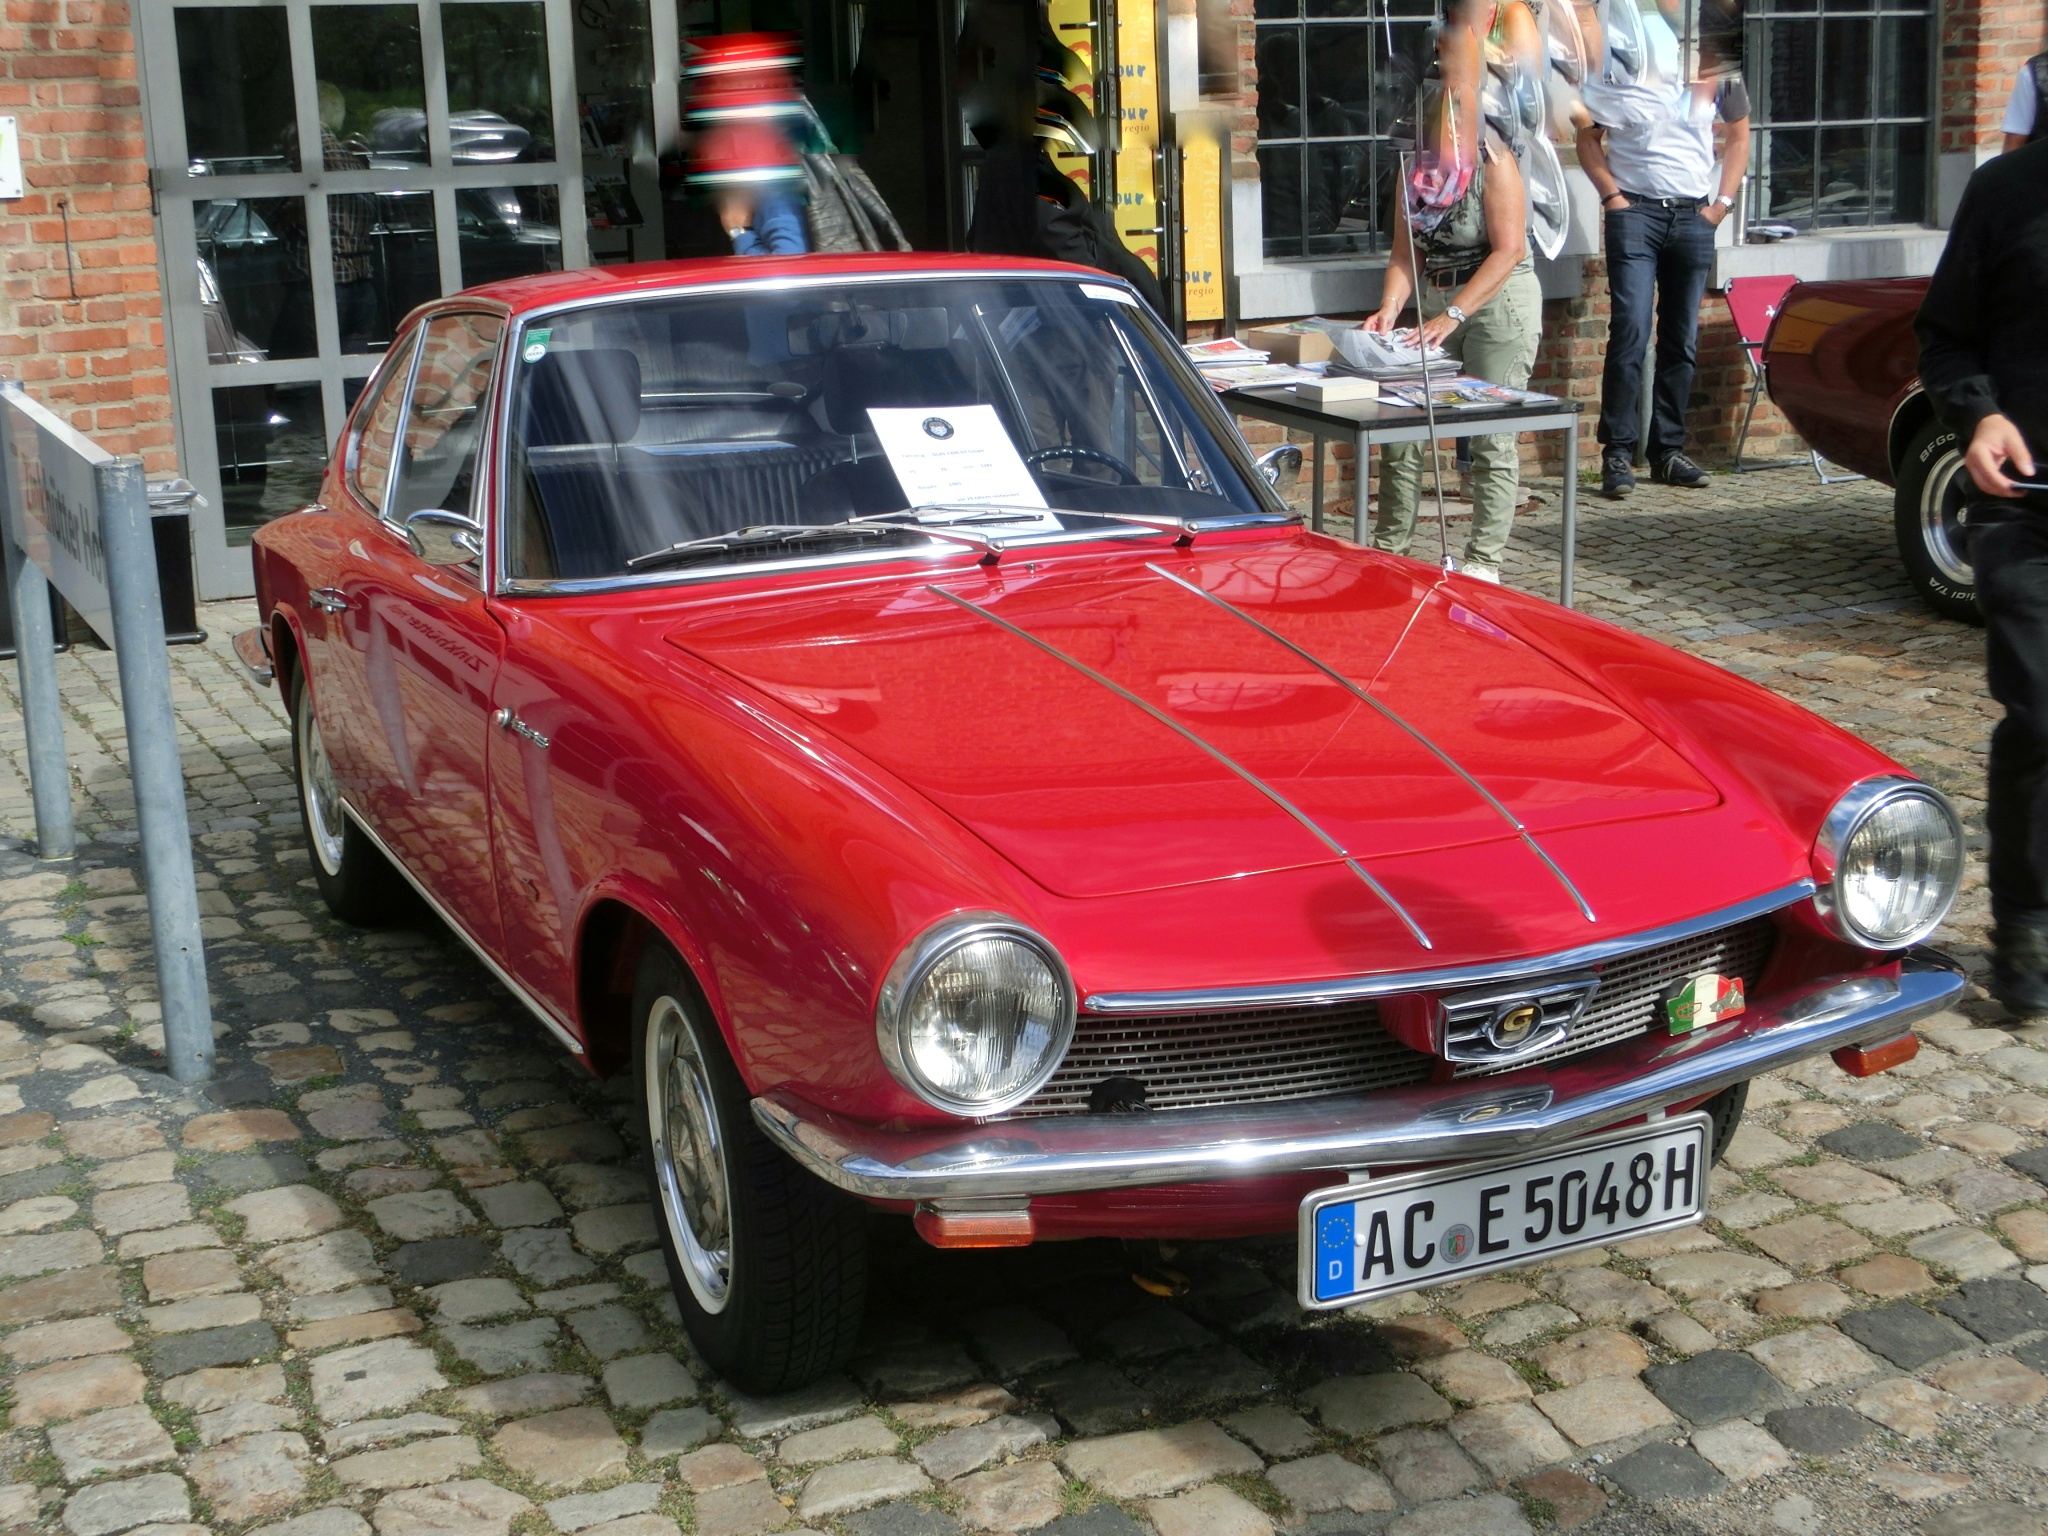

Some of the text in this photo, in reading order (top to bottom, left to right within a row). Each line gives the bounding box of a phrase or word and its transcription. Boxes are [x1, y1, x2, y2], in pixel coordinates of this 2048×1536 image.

[1186, 286, 1215, 298] regio
[1919, 433, 1958, 463] BFGo
[1362, 1201, 1435, 1280] AC
[1328, 1260, 1343, 1281] D
